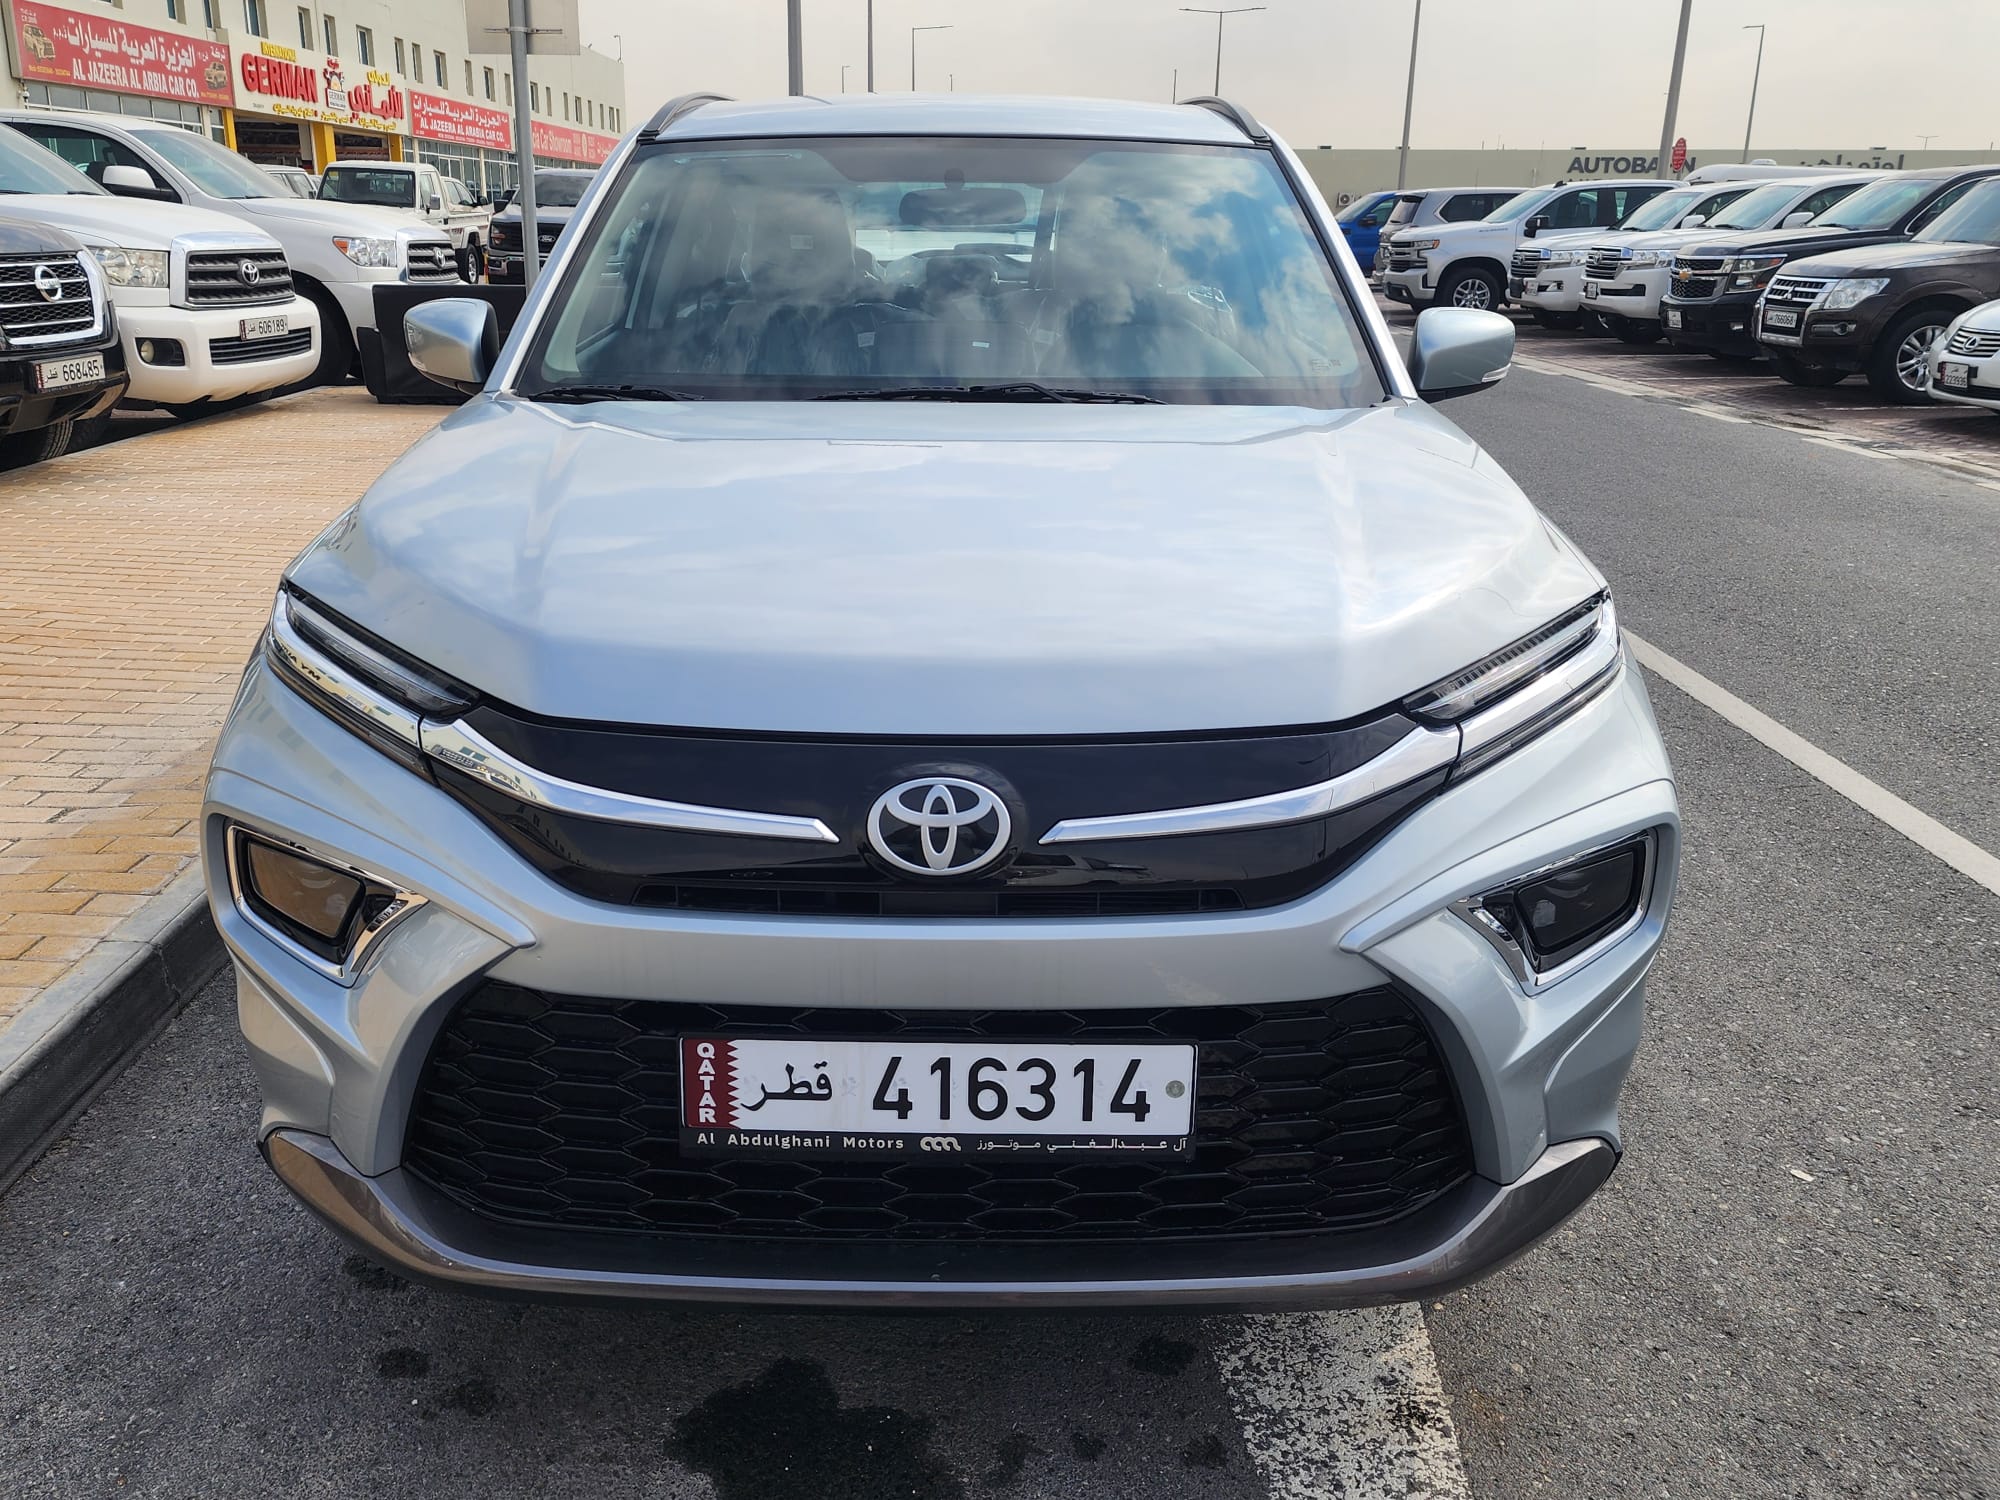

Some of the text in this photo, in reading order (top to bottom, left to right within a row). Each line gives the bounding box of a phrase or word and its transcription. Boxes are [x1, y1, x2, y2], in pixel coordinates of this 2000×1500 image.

[67, 17, 119, 58] للسيارات
[119, 27, 158, 65] العربية
[158, 36, 196, 74] الجزيرة
[72, 58, 87, 81] AL
[87, 61, 129, 87] JAZEERA
[129, 68, 142, 89] AL
[142, 70, 168, 94] ARBIA
[168, 77, 185, 96] CAR
[185, 78, 200, 98] CO.
[241, 53, 318, 104] GERMAN
[413, 95, 501, 129] الجزيرة العربية للسيارات
[420, 117, 429, 129] AL
[429, 119, 456, 134] JAZEERA
[457, 124, 465, 136] AL
[465, 125, 486, 140] ARABIA
[485, 129, 496, 141] CAR
[540, 128, 549, 150] Car
[1566, 156, 1696, 174] AUTOBAN
[258, 319, 285, 334] 606189
[62, 359, 100, 382] 668485
[697, 1042, 716, 1124] QATAR
[740, 1056, 1151, 1122] قطر 416314
[697, 1132, 904, 1149] Al Abdulghani Motors
[976, 1138, 1041, 1152] موتورز
[1173, 1137, 1188, 1152] آل
